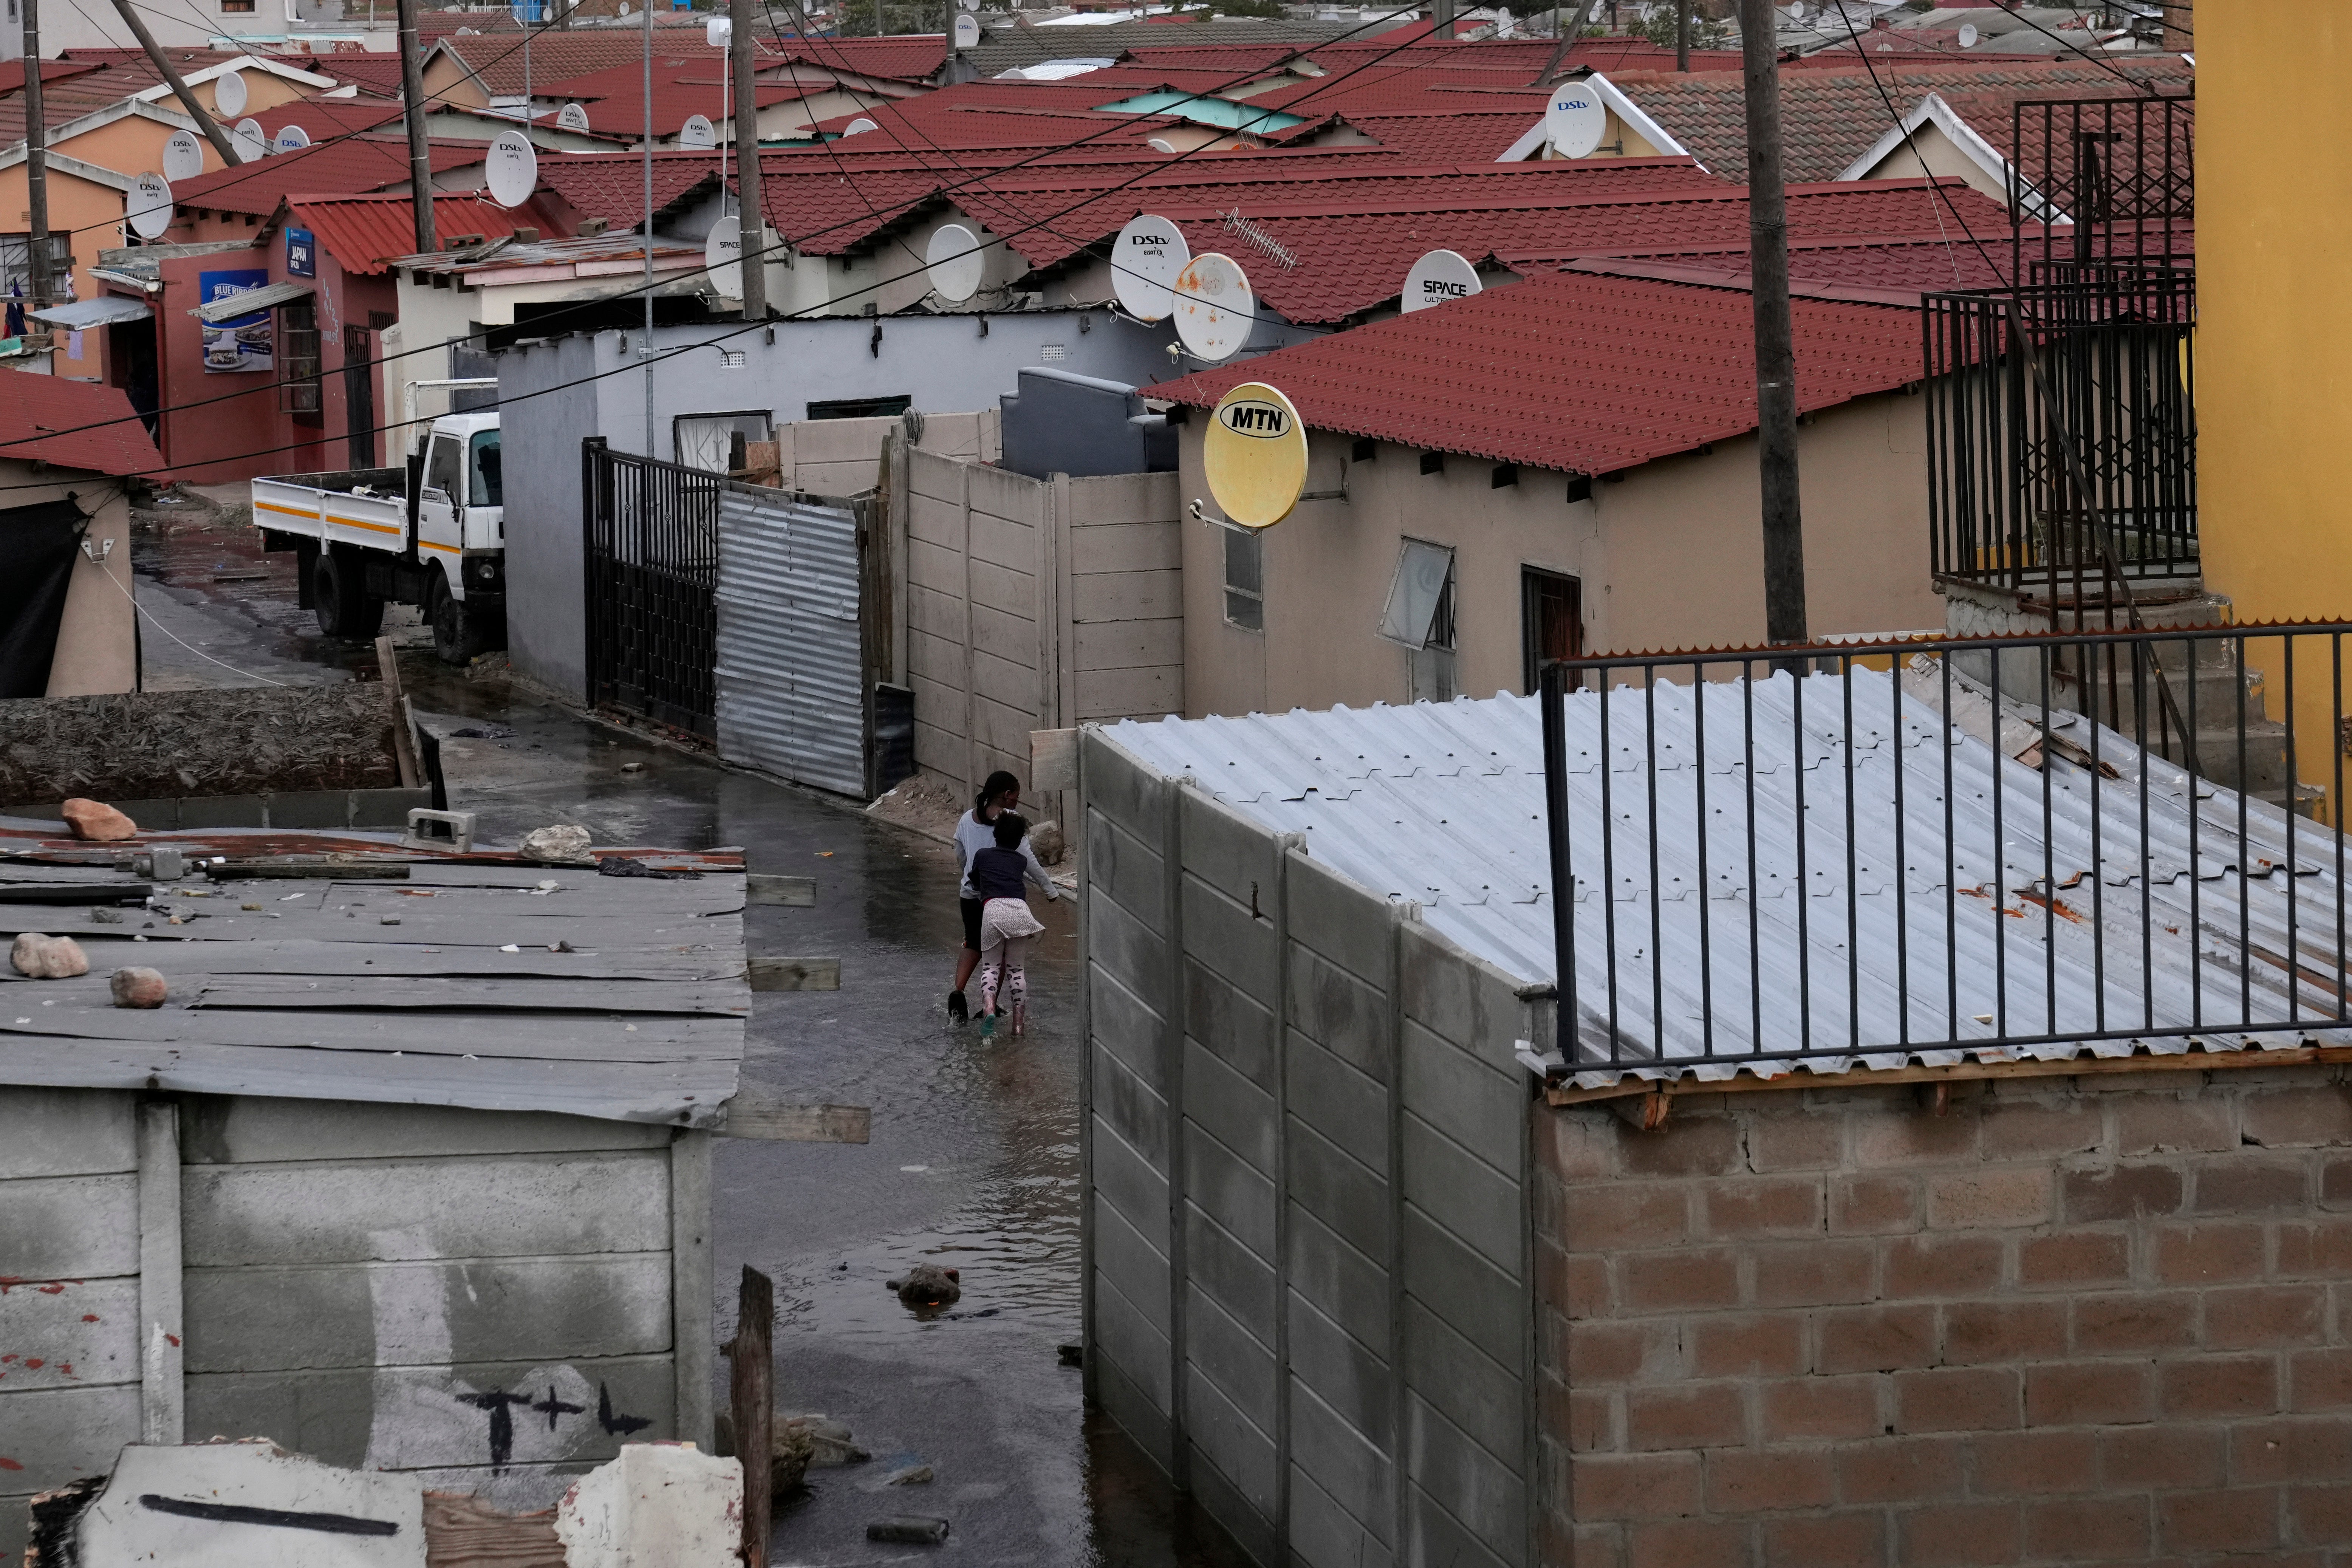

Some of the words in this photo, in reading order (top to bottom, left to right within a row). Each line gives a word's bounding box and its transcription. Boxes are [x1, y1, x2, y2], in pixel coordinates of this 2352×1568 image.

[1558, 101, 1589, 110] DStv
[1132, 235, 1170, 245] DStv
[291, 246, 306, 262] JAPAN
[290, 260, 299, 269] SPAZA
[215, 285, 232, 295] BLUE
[1424, 280, 1467, 297] SPACE
[1232, 407, 1282, 432] MTN
